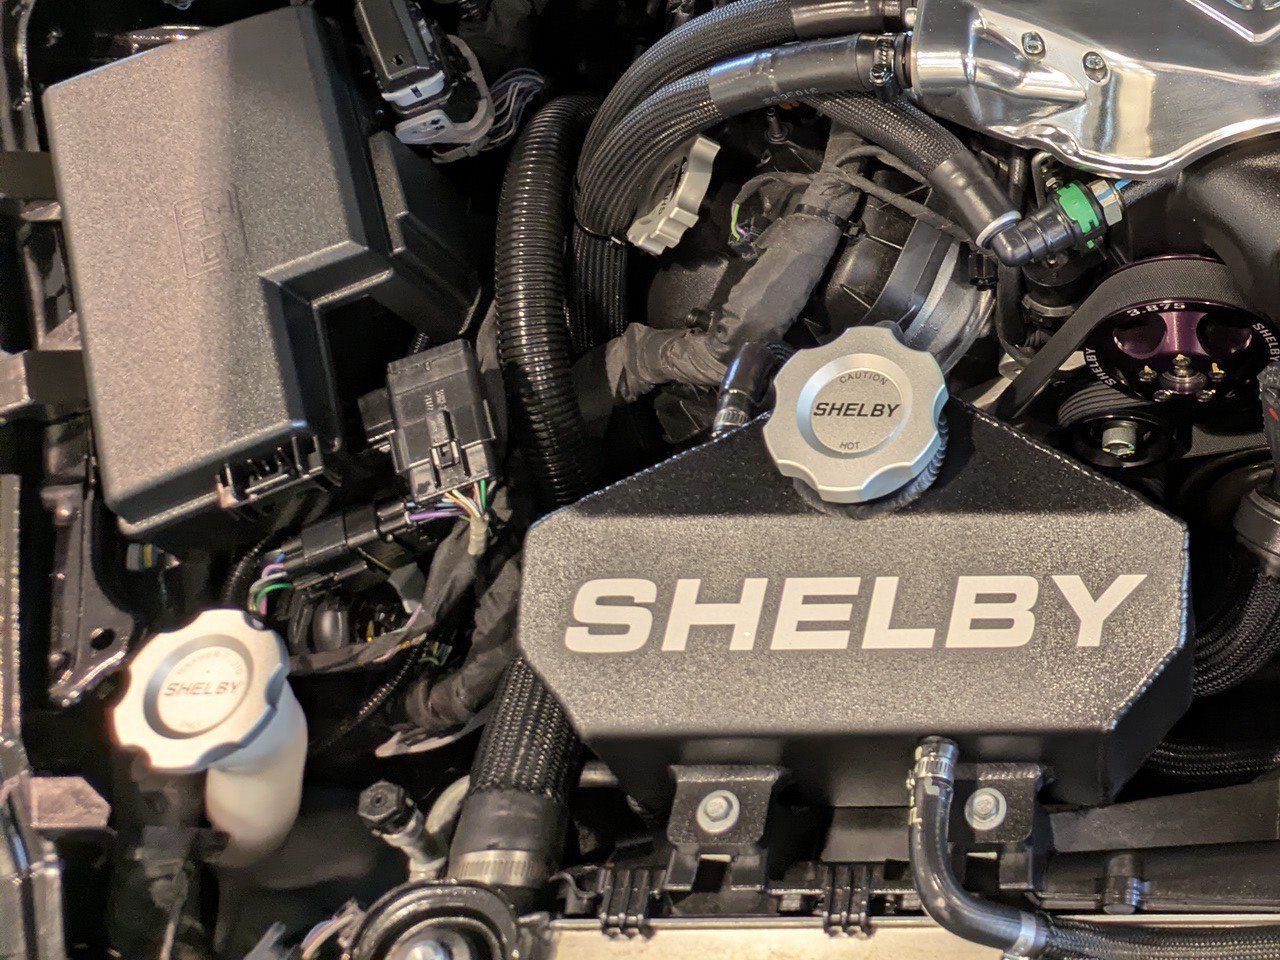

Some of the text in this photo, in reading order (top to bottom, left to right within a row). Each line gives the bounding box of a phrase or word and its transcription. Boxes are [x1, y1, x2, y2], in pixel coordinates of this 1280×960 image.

[1126, 302, 1186, 317] 3.875
[1252, 322, 1280, 363] SHELBY
[1085, 347, 1117, 387] SHELBY
[839, 372, 888, 386] CAUTION
[813, 402, 901, 418] SHELBY
[839, 441, 861, 450] HOT
[565, 573, 1148, 653] SHELBY
[164, 680, 241, 697] SHELBY
